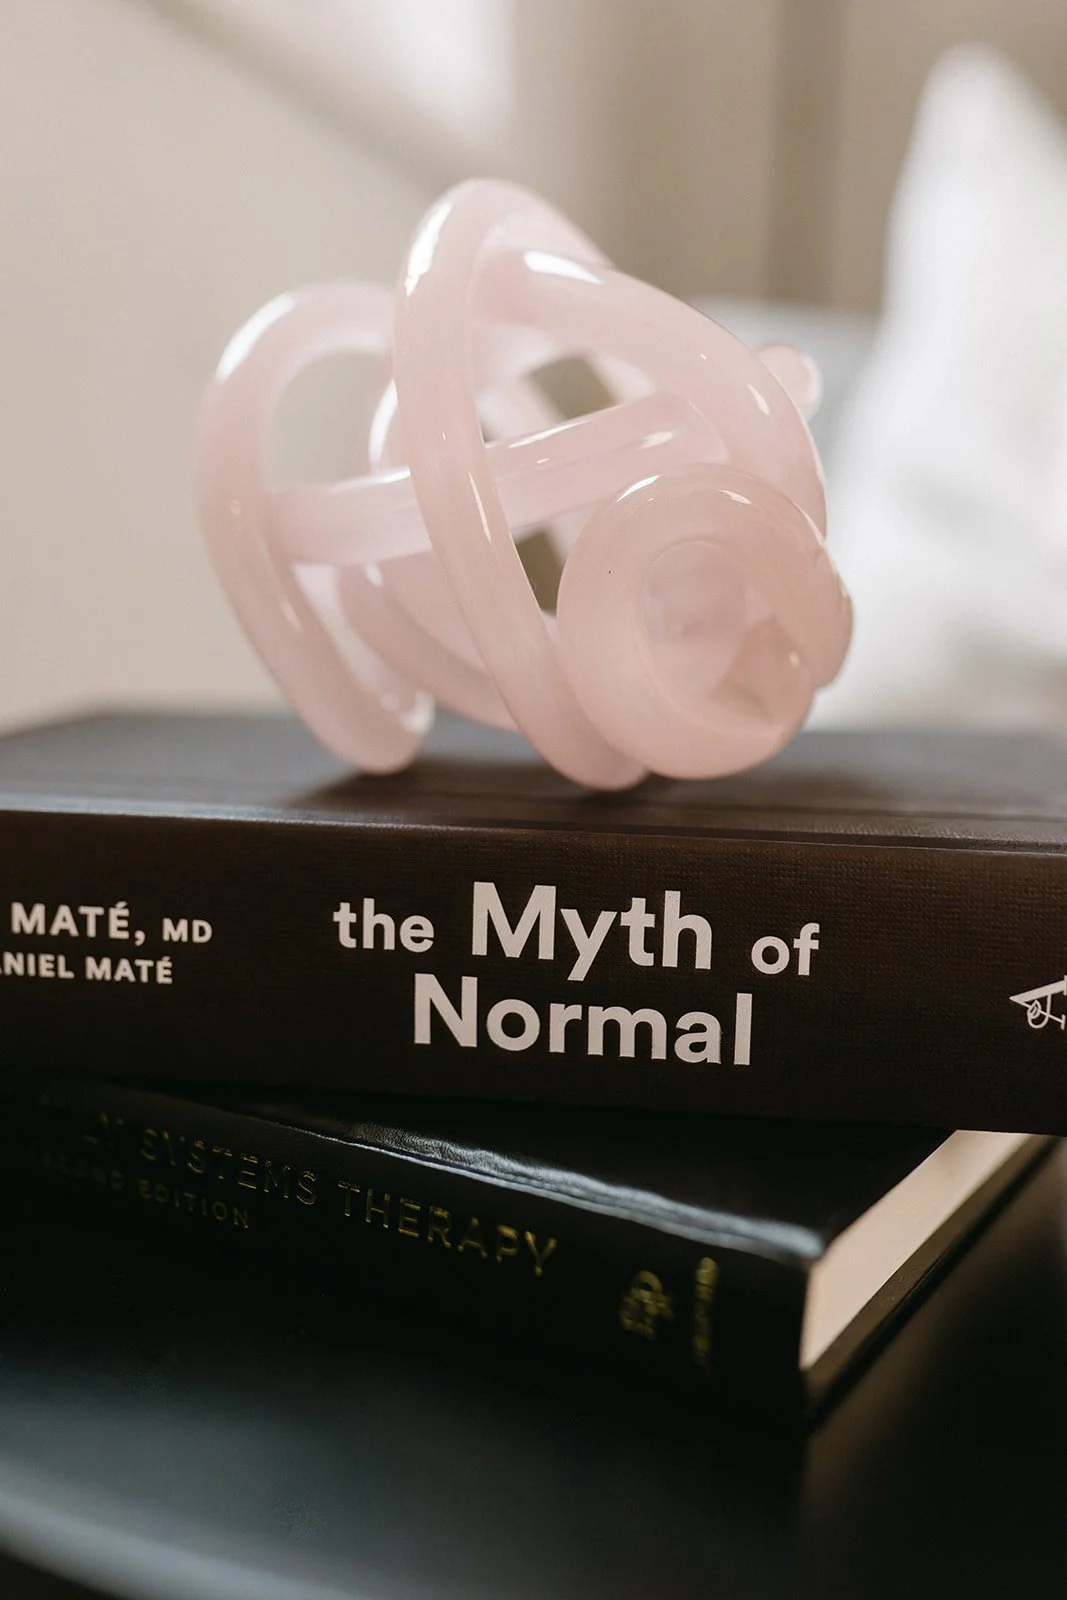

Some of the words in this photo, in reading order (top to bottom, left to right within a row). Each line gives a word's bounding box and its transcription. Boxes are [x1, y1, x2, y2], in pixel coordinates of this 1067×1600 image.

[10, 901, 146, 947] MATÉ,
[162, 917, 213, 943] MD
[333, 897, 435, 954] the
[471, 881, 713, 982] Myth
[751, 922, 820, 977] of
[0, 951, 75, 979] NIEL
[85, 956, 174, 985] MATÉ
[413, 973, 753, 1066] Normal
[138, 1177, 250, 1230] EDITION
[140, 1127, 316, 1206] SYSTEMS
[337, 1178, 559, 1278] THERAPY
